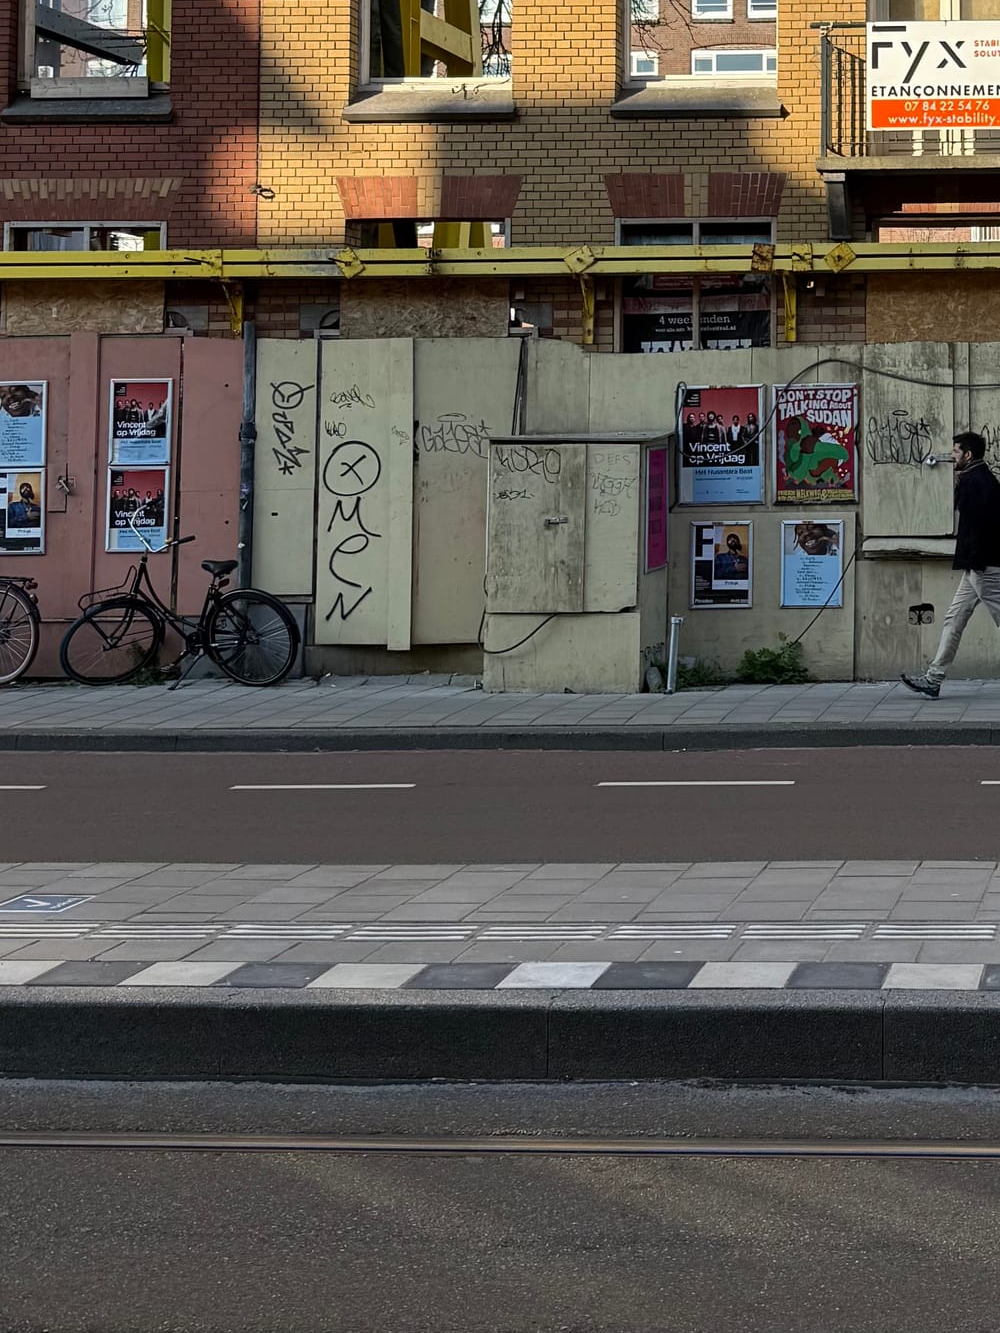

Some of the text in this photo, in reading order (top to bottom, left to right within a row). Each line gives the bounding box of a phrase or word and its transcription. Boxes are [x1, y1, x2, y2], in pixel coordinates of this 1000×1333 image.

[904, 100, 990, 112] 07 84 22 54 76
[659, 315, 666, 325] 4
[778, 390, 852, 403] DON'T STOP
[778, 399, 828, 421] TALKING
[806, 410, 852, 427] SUDAN
[689, 442, 731, 452] Vincent
